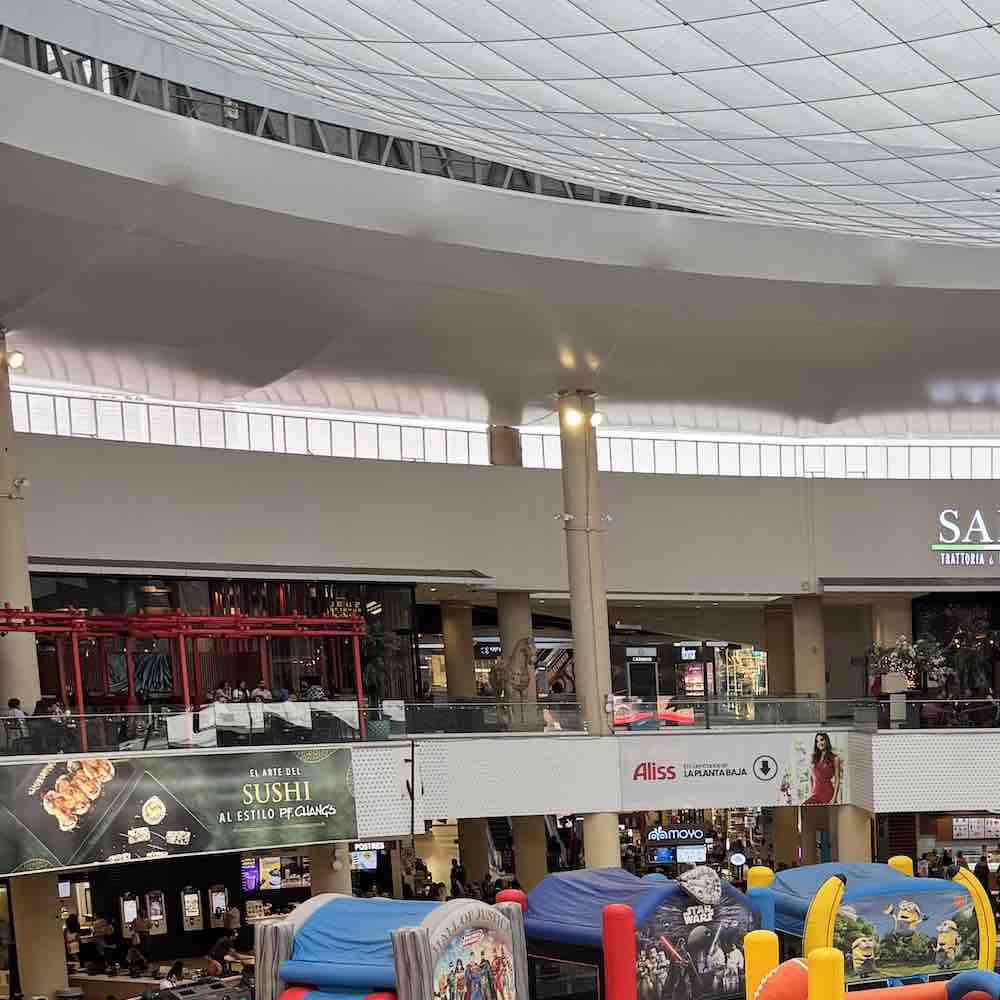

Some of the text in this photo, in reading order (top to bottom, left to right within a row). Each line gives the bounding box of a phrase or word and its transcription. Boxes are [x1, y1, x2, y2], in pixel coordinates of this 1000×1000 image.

[940, 552, 985, 566] TRATTORIA
[249, 767, 301, 778] EL ARTE DEL
[632, 762, 677, 781] Aliss
[684, 767, 748, 778] LA PLANTA BAJA
[242, 780, 313, 805] SUSHI
[218, 812, 233, 824] AL
[237, 808, 275, 822] ESTILO
[683, 908, 715, 925] WARS
[686, 904, 712, 917] STAR
